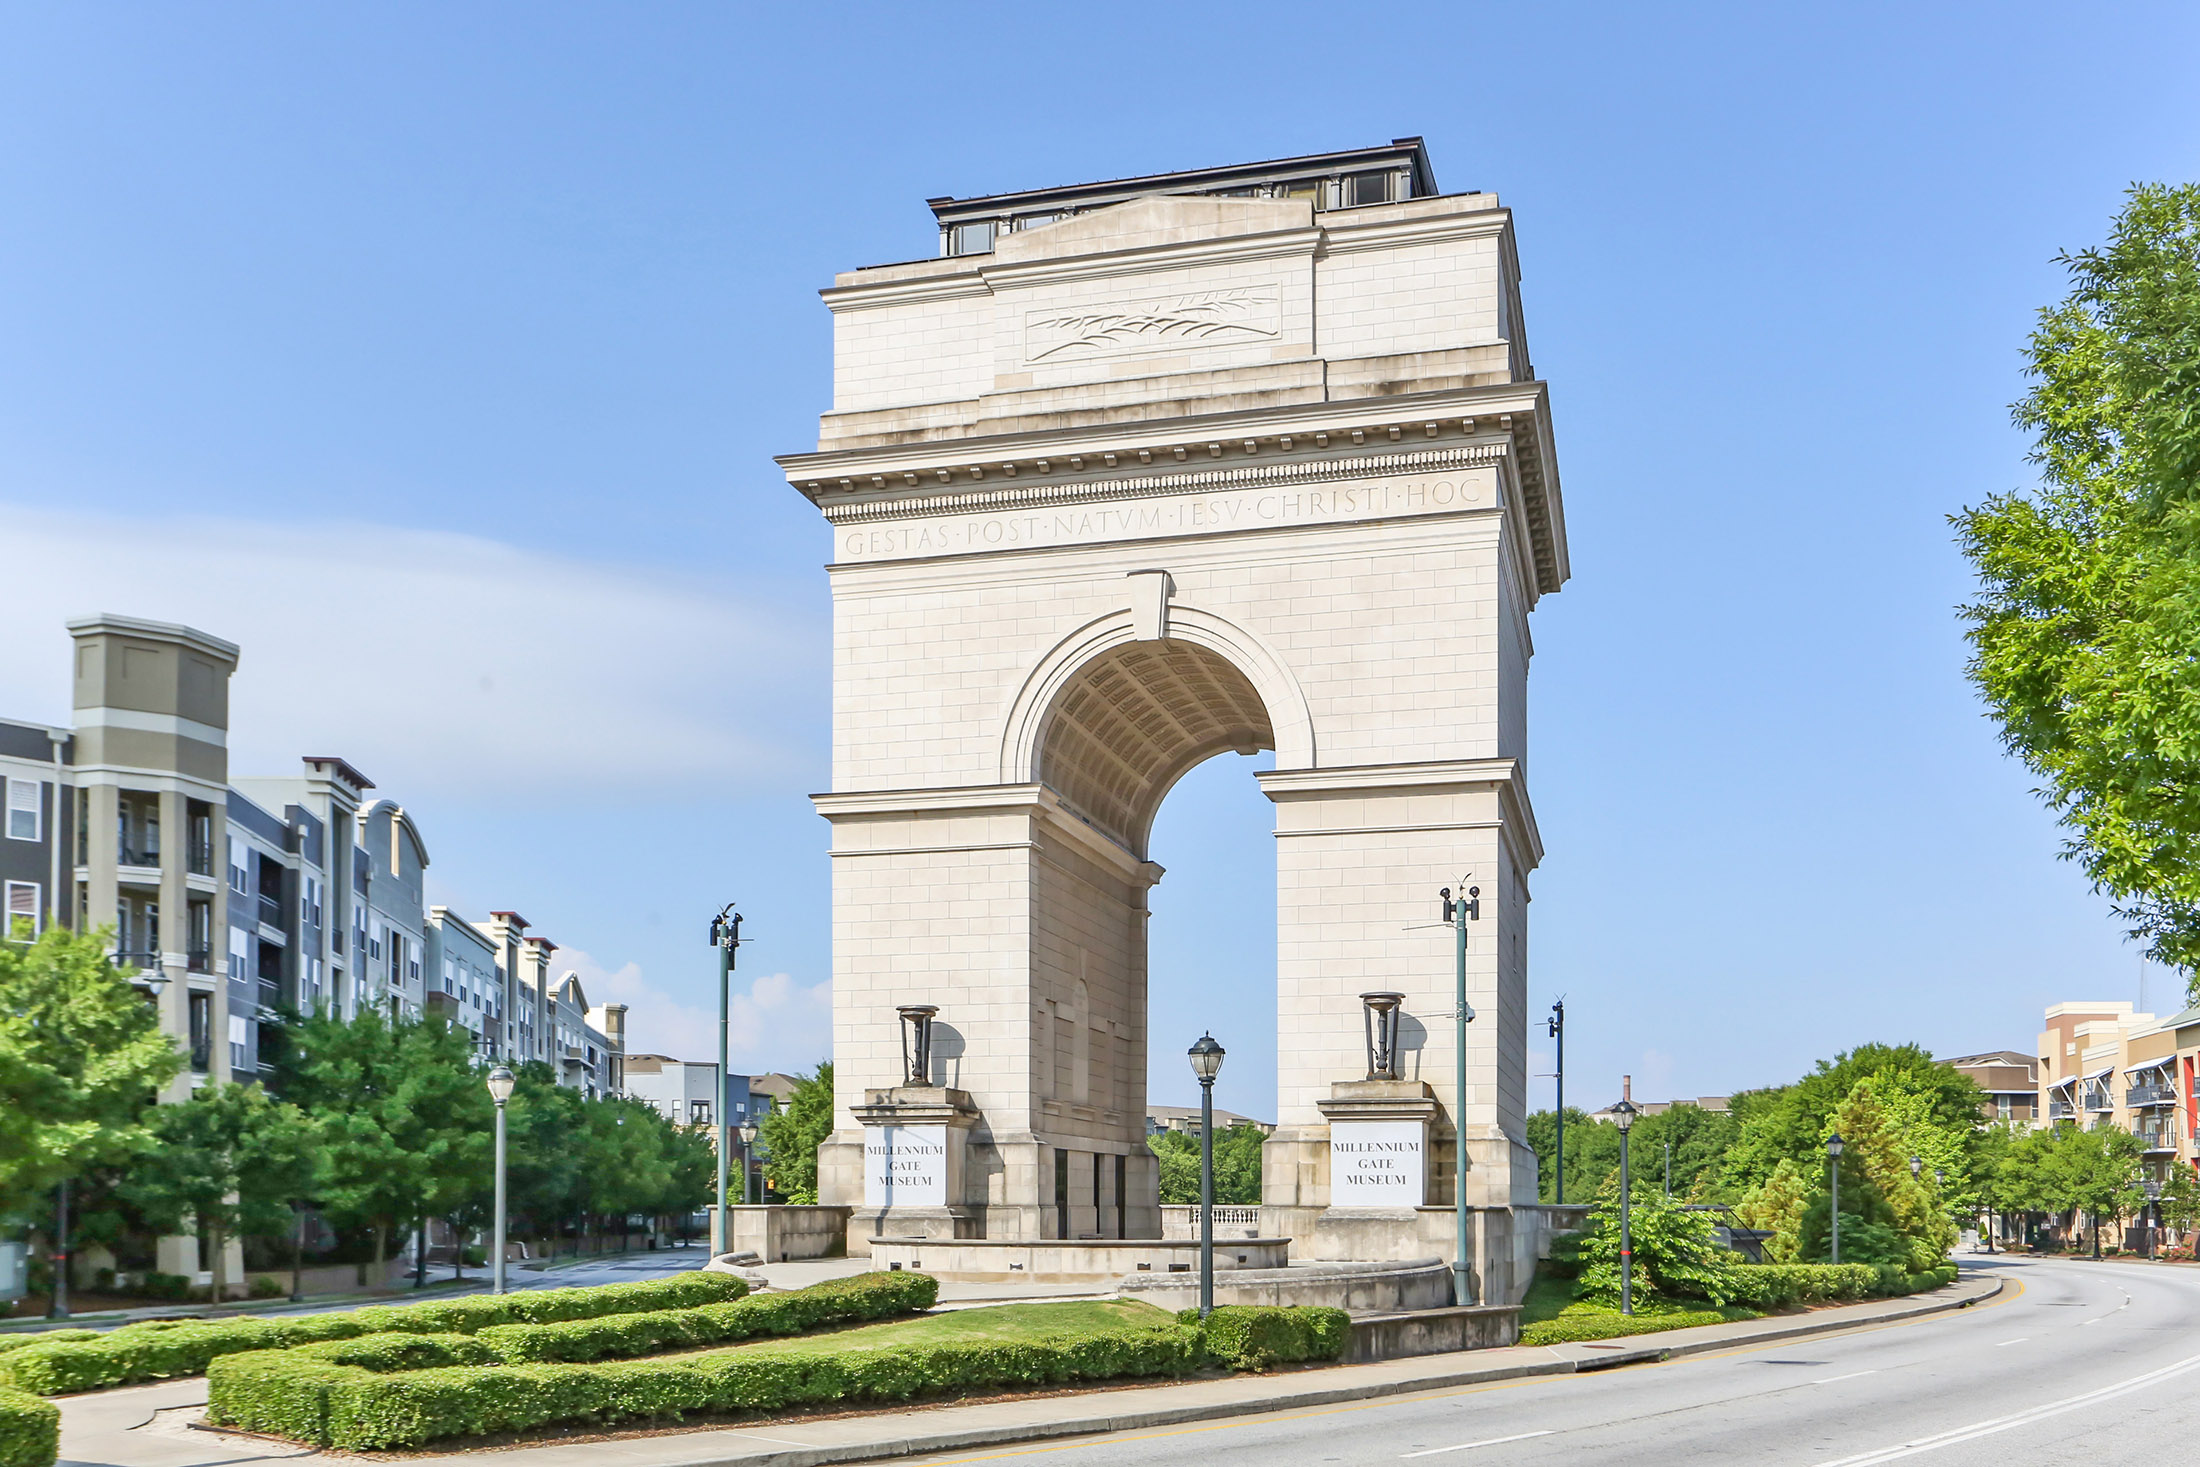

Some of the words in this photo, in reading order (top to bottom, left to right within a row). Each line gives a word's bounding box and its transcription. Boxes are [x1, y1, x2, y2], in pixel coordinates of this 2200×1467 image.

[845, 525, 949, 555] GESTAS
[968, 517, 1040, 545] POST
[1054, 507, 1161, 537] NATVM
[1179, 499, 1243, 527] IESV
[1256, 486, 1390, 520] CHRISTI
[1407, 478, 1481, 507] HOC
[867, 1146, 943, 1155] MILLENNIUM
[1334, 1142, 1419, 1152] MILLENNIUM
[889, 1161, 921, 1171] GATE
[1358, 1159, 1394, 1169] GATE
[878, 1176, 932, 1186] MUSEUM
[1346, 1175, 1407, 1185] MUSEUM
